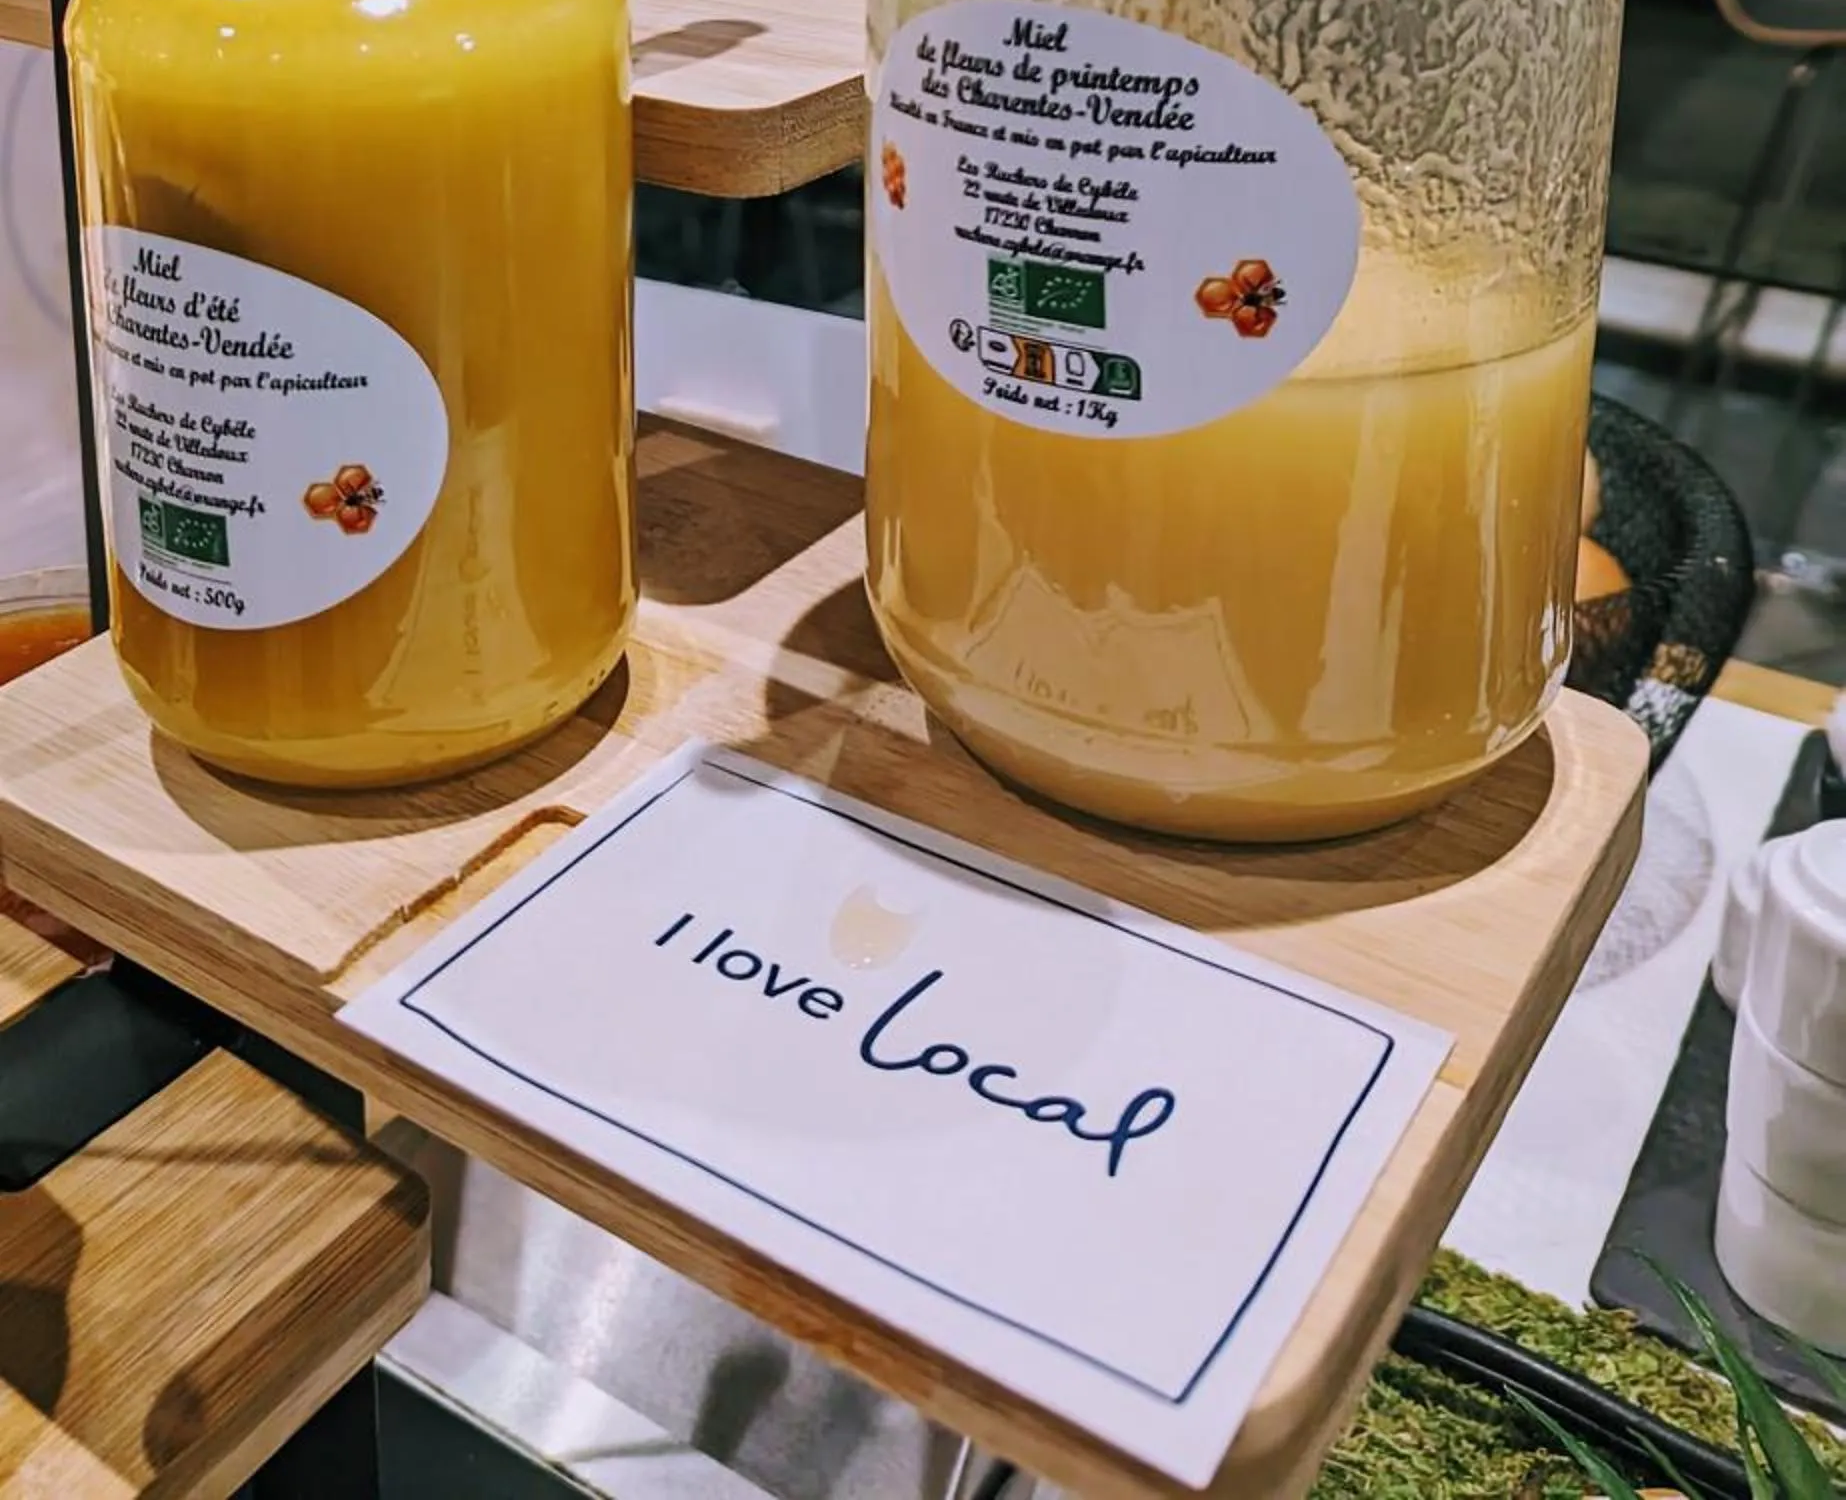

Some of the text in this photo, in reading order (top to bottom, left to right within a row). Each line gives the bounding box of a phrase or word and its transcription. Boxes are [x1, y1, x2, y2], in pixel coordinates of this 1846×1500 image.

[1002, 17, 1068, 51] Miel
[917, 33, 1200, 100] de fleurs de printemps
[921, 67, 1195, 130] des Charentes-Vendée
[942, 109, 988, 138] France
[992, 126, 1007, 141] et
[1010, 128, 1039, 147] mis
[1045, 138, 1066, 152] en
[1070, 139, 1102, 159] pot
[1107, 143, 1146, 163] par
[1150, 140, 1278, 169] l'apiculteur
[957, 154, 979, 176] Les
[1053, 173, 1073, 193] de
[963, 179, 981, 199] 22
[1021, 190, 1041, 211] de
[132, 247, 182, 282] Miel
[122, 274, 176, 314] fleurs
[184, 291, 241, 323] d'été
[189, 369, 215, 387] pot
[220, 374, 252, 392] par
[256, 370, 368, 396] l'apiculteur
[982, 377, 1029, 405] Poids
[1033, 396, 1061, 412] net
[156, 430, 171, 448] de
[179, 412, 197, 431] de
[171, 583, 191, 599] net
[203, 587, 245, 616] 500g
[655, 913, 695, 947] I
[692, 928, 844, 1020] love
